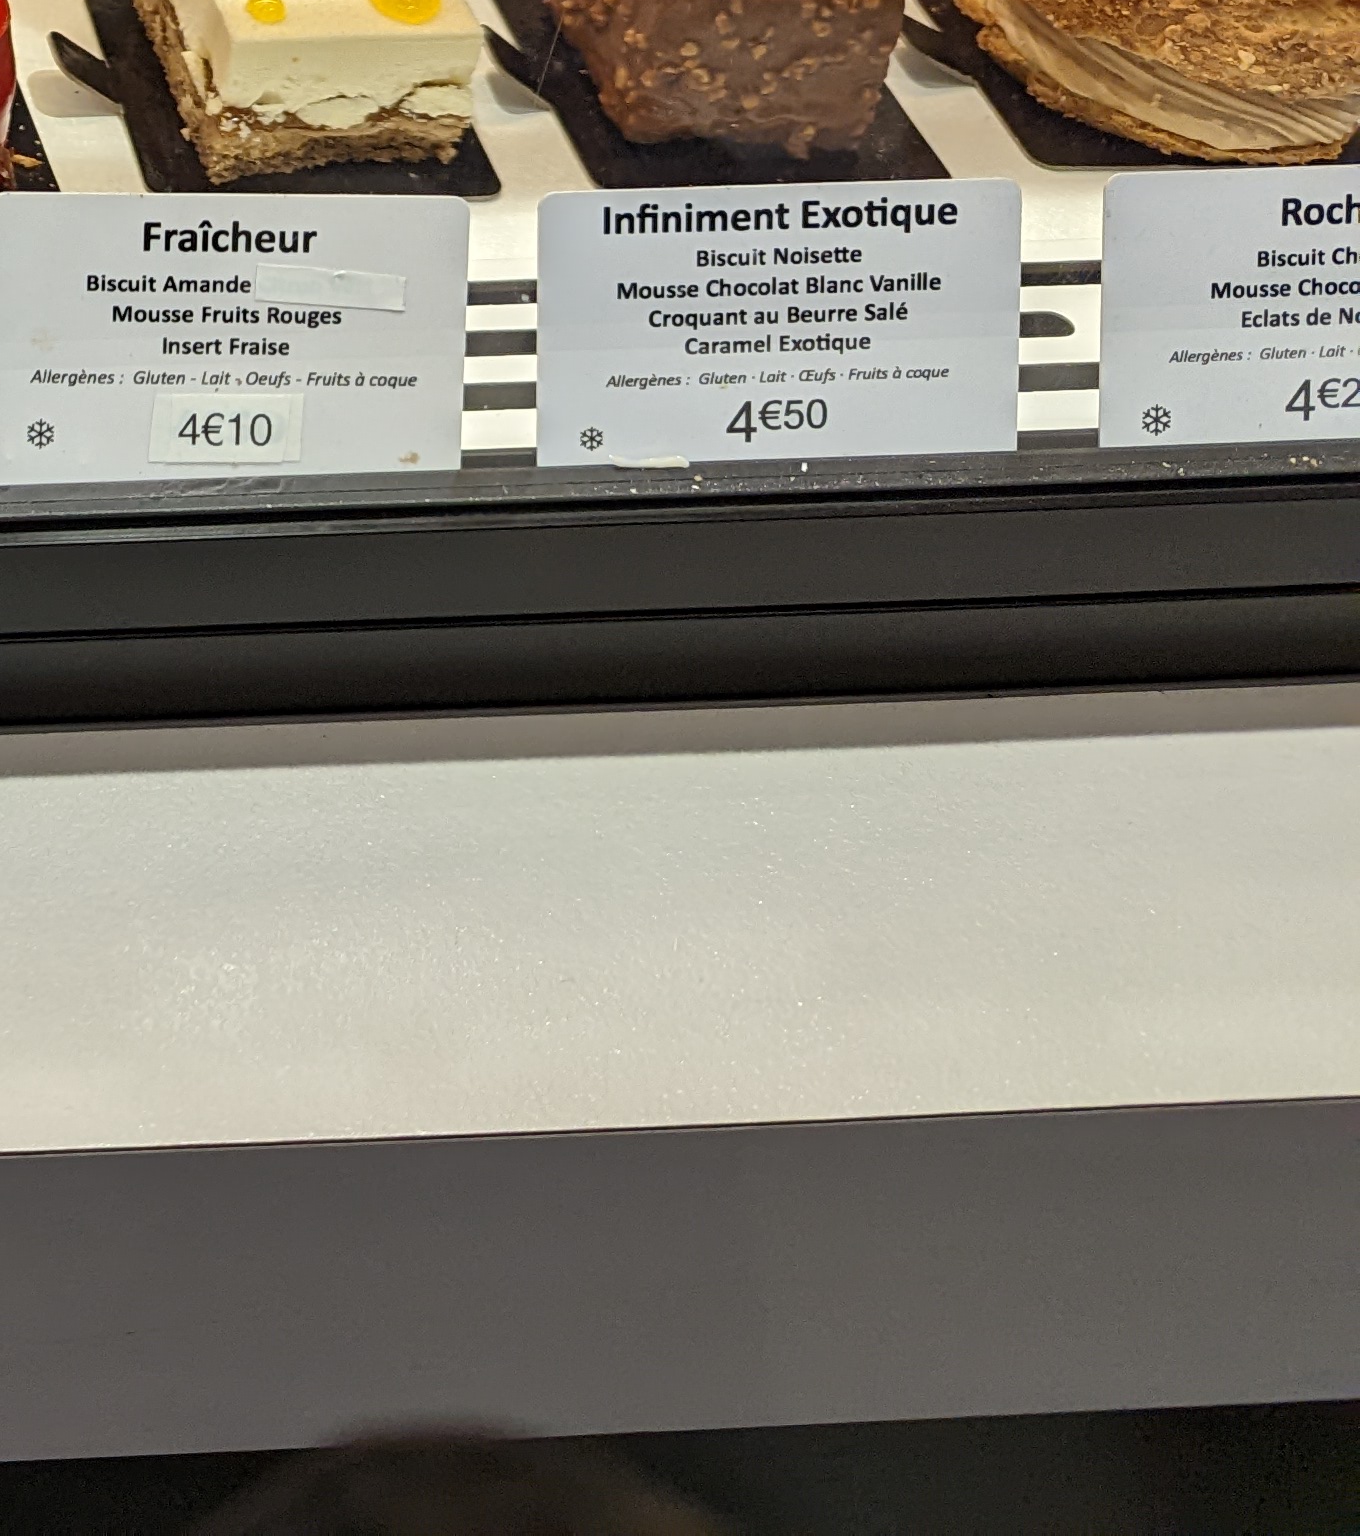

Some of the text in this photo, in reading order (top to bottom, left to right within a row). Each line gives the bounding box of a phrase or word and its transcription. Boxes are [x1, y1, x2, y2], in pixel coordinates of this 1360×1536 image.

[604, 197, 957, 234] Infiniment Exotique
[144, 220, 317, 253] Fraîcheur
[697, 247, 862, 267] Biscuit Noisette
[1258, 247, 1360, 267] Biscuit Ch
[87, 275, 251, 293] Biscuit Amande
[618, 272, 941, 299] Mousse Chocolat Blanc Vanille
[1211, 282, 1291, 299] Mousse
[113, 306, 341, 328] Mousse Fruits Rouges
[649, 302, 908, 330] Croquant au Beurre Salé
[1242, 309, 1300, 328] Eclats
[1306, 308, 1331, 326] de
[163, 338, 289, 355] Insert Fraise
[685, 333, 870, 354] Caramel Exotique
[1169, 349, 1242, 365] Allergènes
[1260, 347, 1306, 360] Gluten
[1319, 345, 1346, 358] Lait
[30, 370, 114, 386] Allergènes
[133, 371, 185, 384] Gluten
[202, 371, 231, 387] Lait
[246, 371, 291, 388] Oeufs
[307, 372, 350, 386] Fruits
[355, 372, 365, 386] à
[369, 376, 417, 389] coque
[606, 374, 681, 390] Allergènes
[699, 372, 747, 385] Gluten
[760, 371, 787, 383] Lait
[849, 368, 888, 380] Fruits
[892, 366, 902, 379] à
[906, 369, 949, 381] coque
[178, 413, 272, 446] 4€10
[726, 399, 827, 442] 4€50
